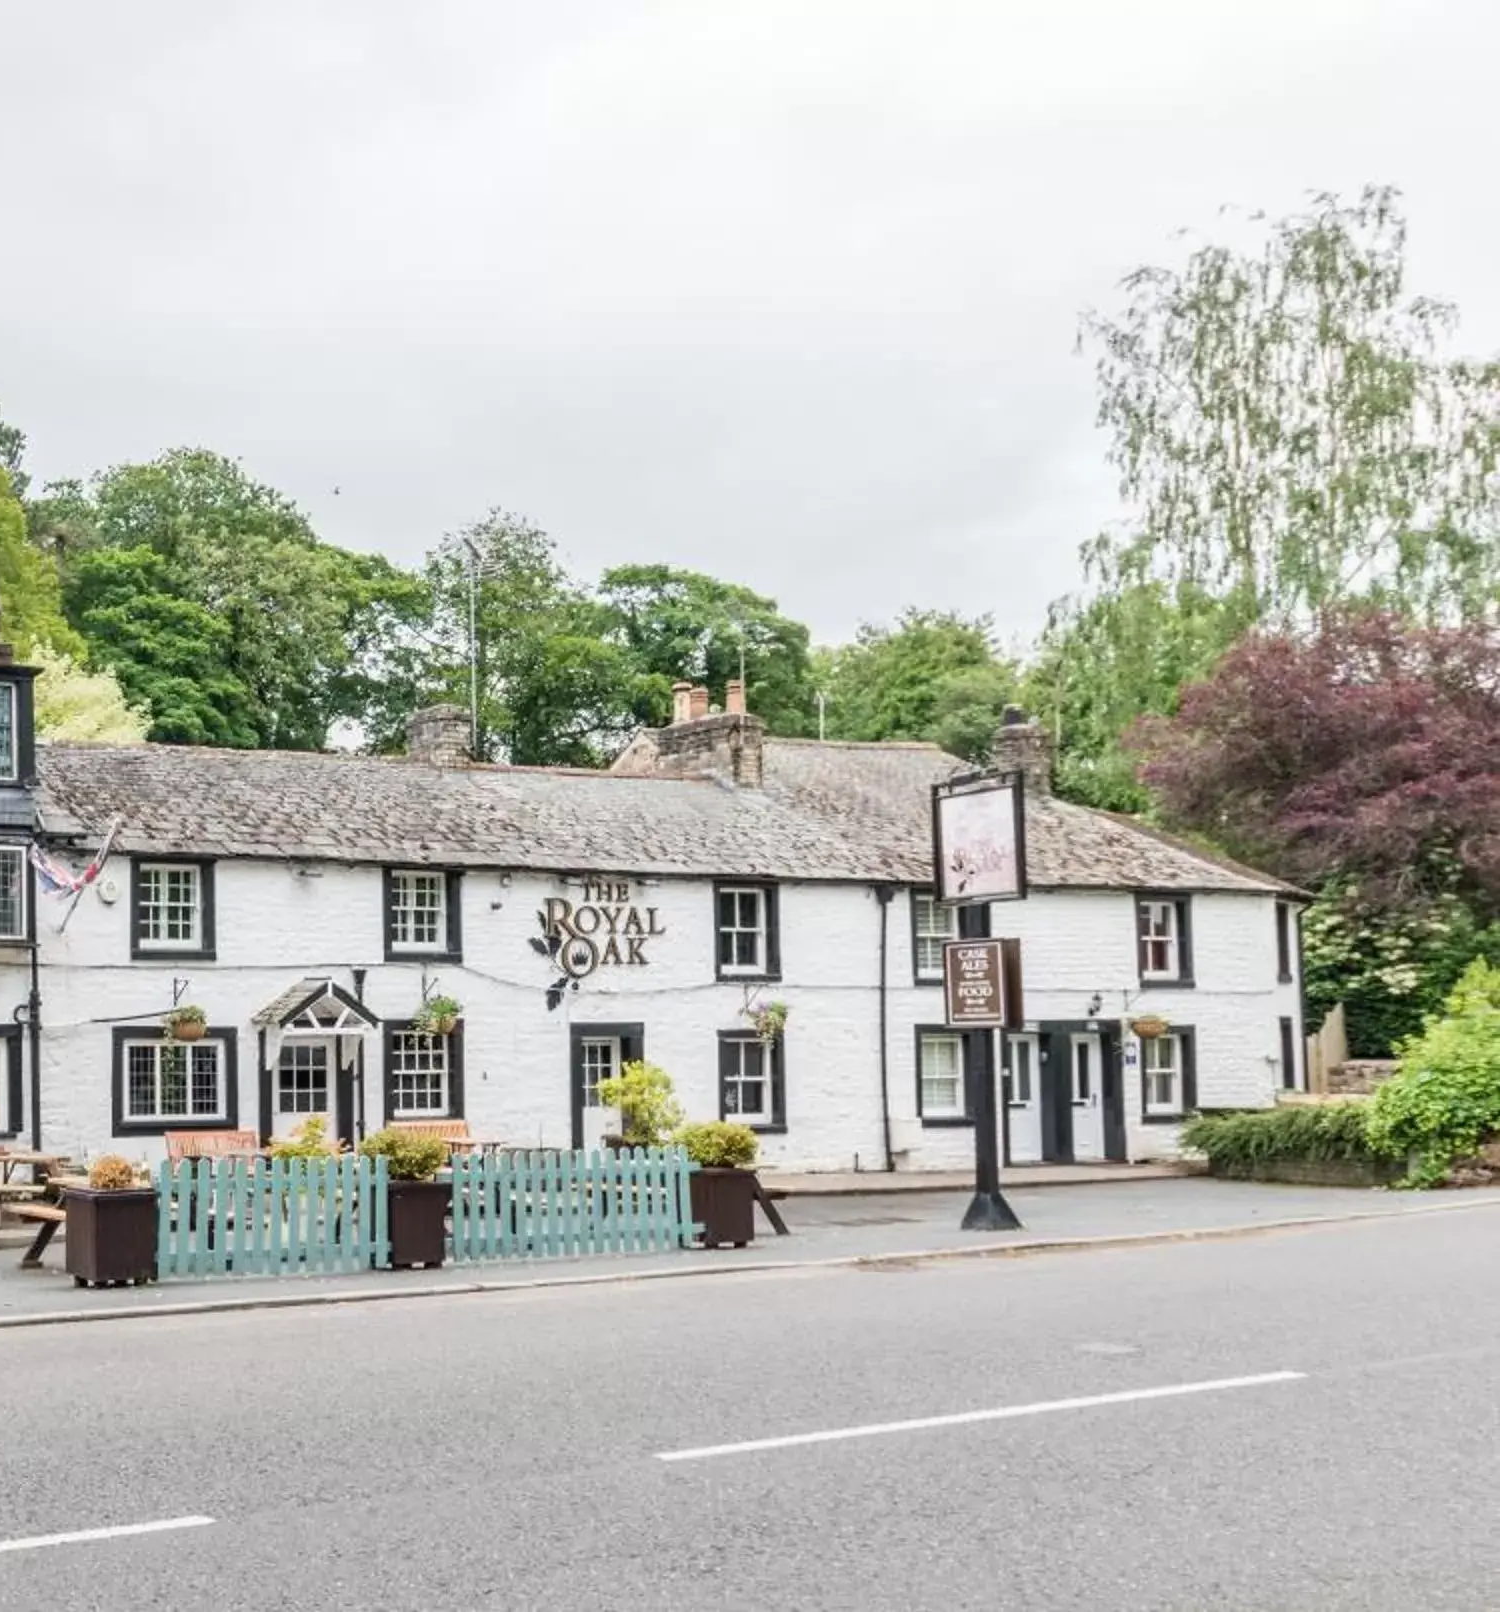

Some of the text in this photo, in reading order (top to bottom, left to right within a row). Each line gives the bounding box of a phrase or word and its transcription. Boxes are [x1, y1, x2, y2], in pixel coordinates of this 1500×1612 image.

[581, 880, 629, 902] THE
[543, 897, 666, 938] ROYAL
[561, 936, 649, 979] OAK
[958, 985, 993, 998] FOOD
